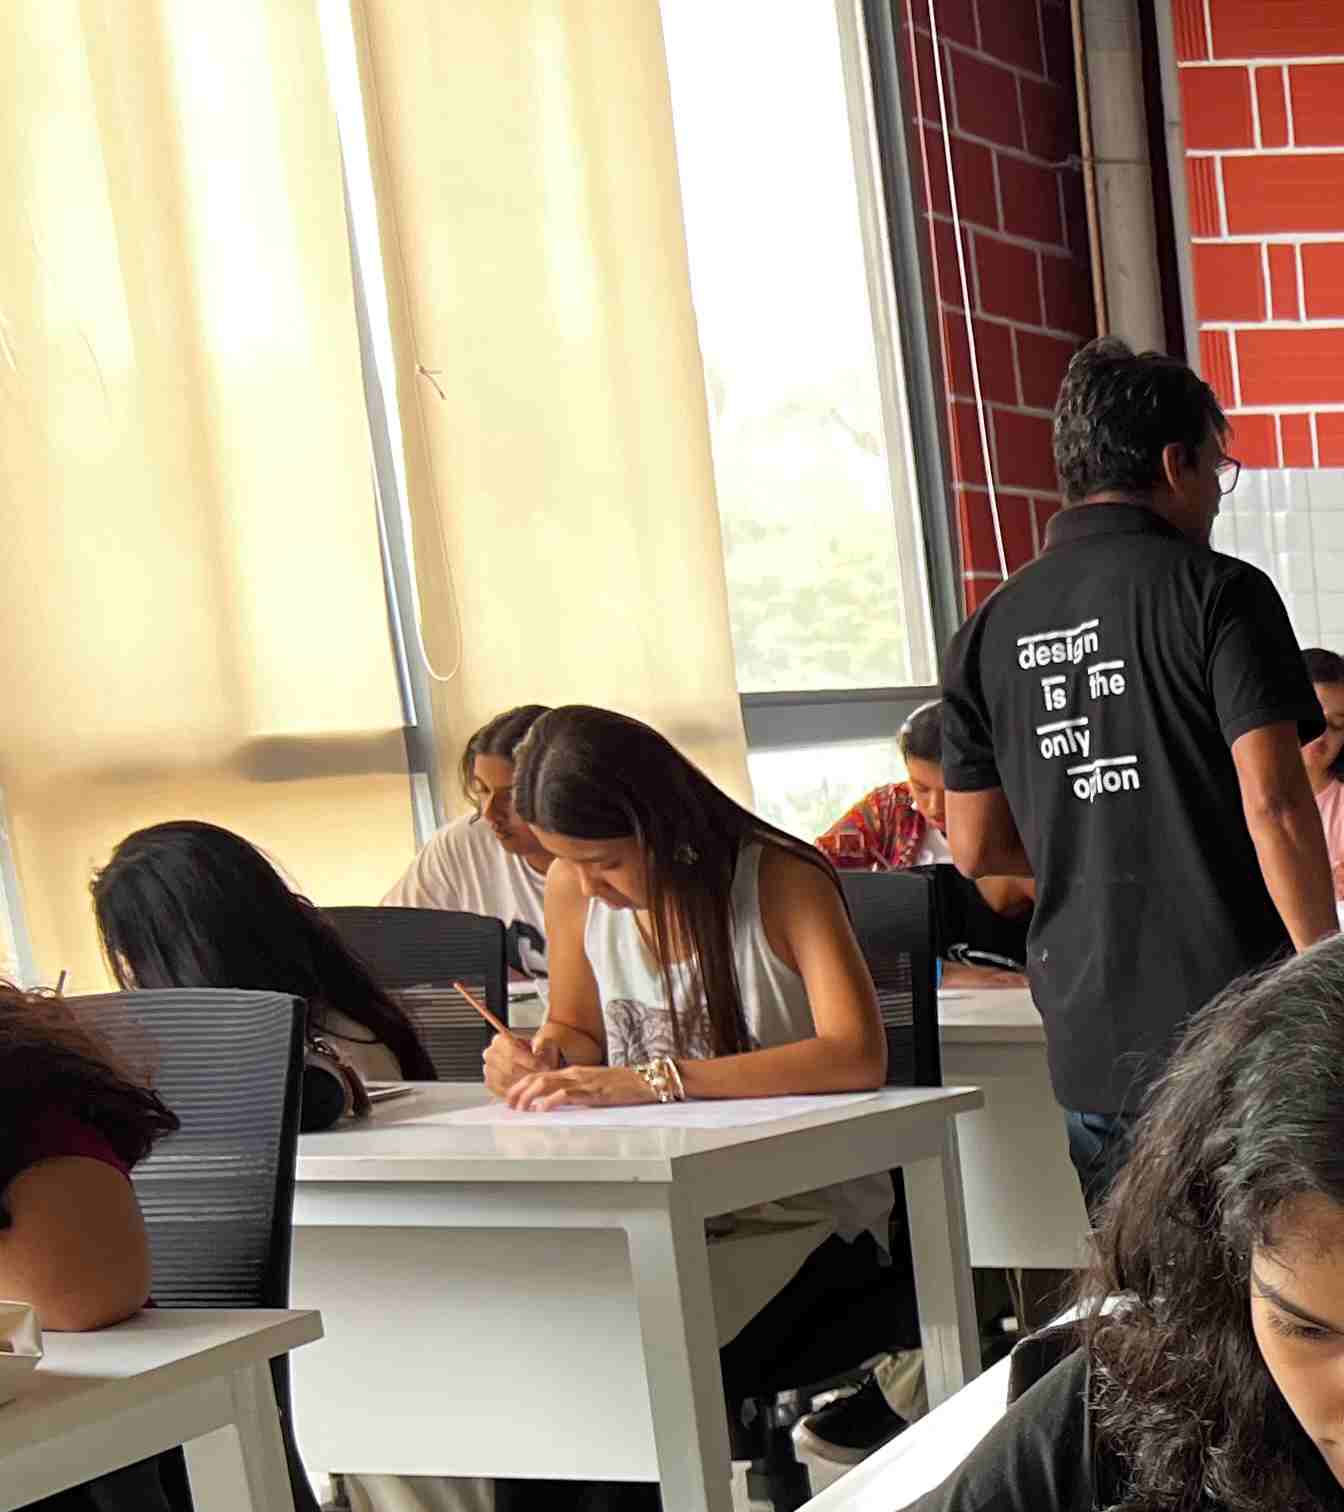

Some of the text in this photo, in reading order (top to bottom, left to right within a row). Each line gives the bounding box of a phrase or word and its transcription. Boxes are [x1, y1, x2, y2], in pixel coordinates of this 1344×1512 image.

[1017, 630, 1099, 669] design
[1043, 671, 1126, 711] is the
[1040, 727, 1090, 759] only
